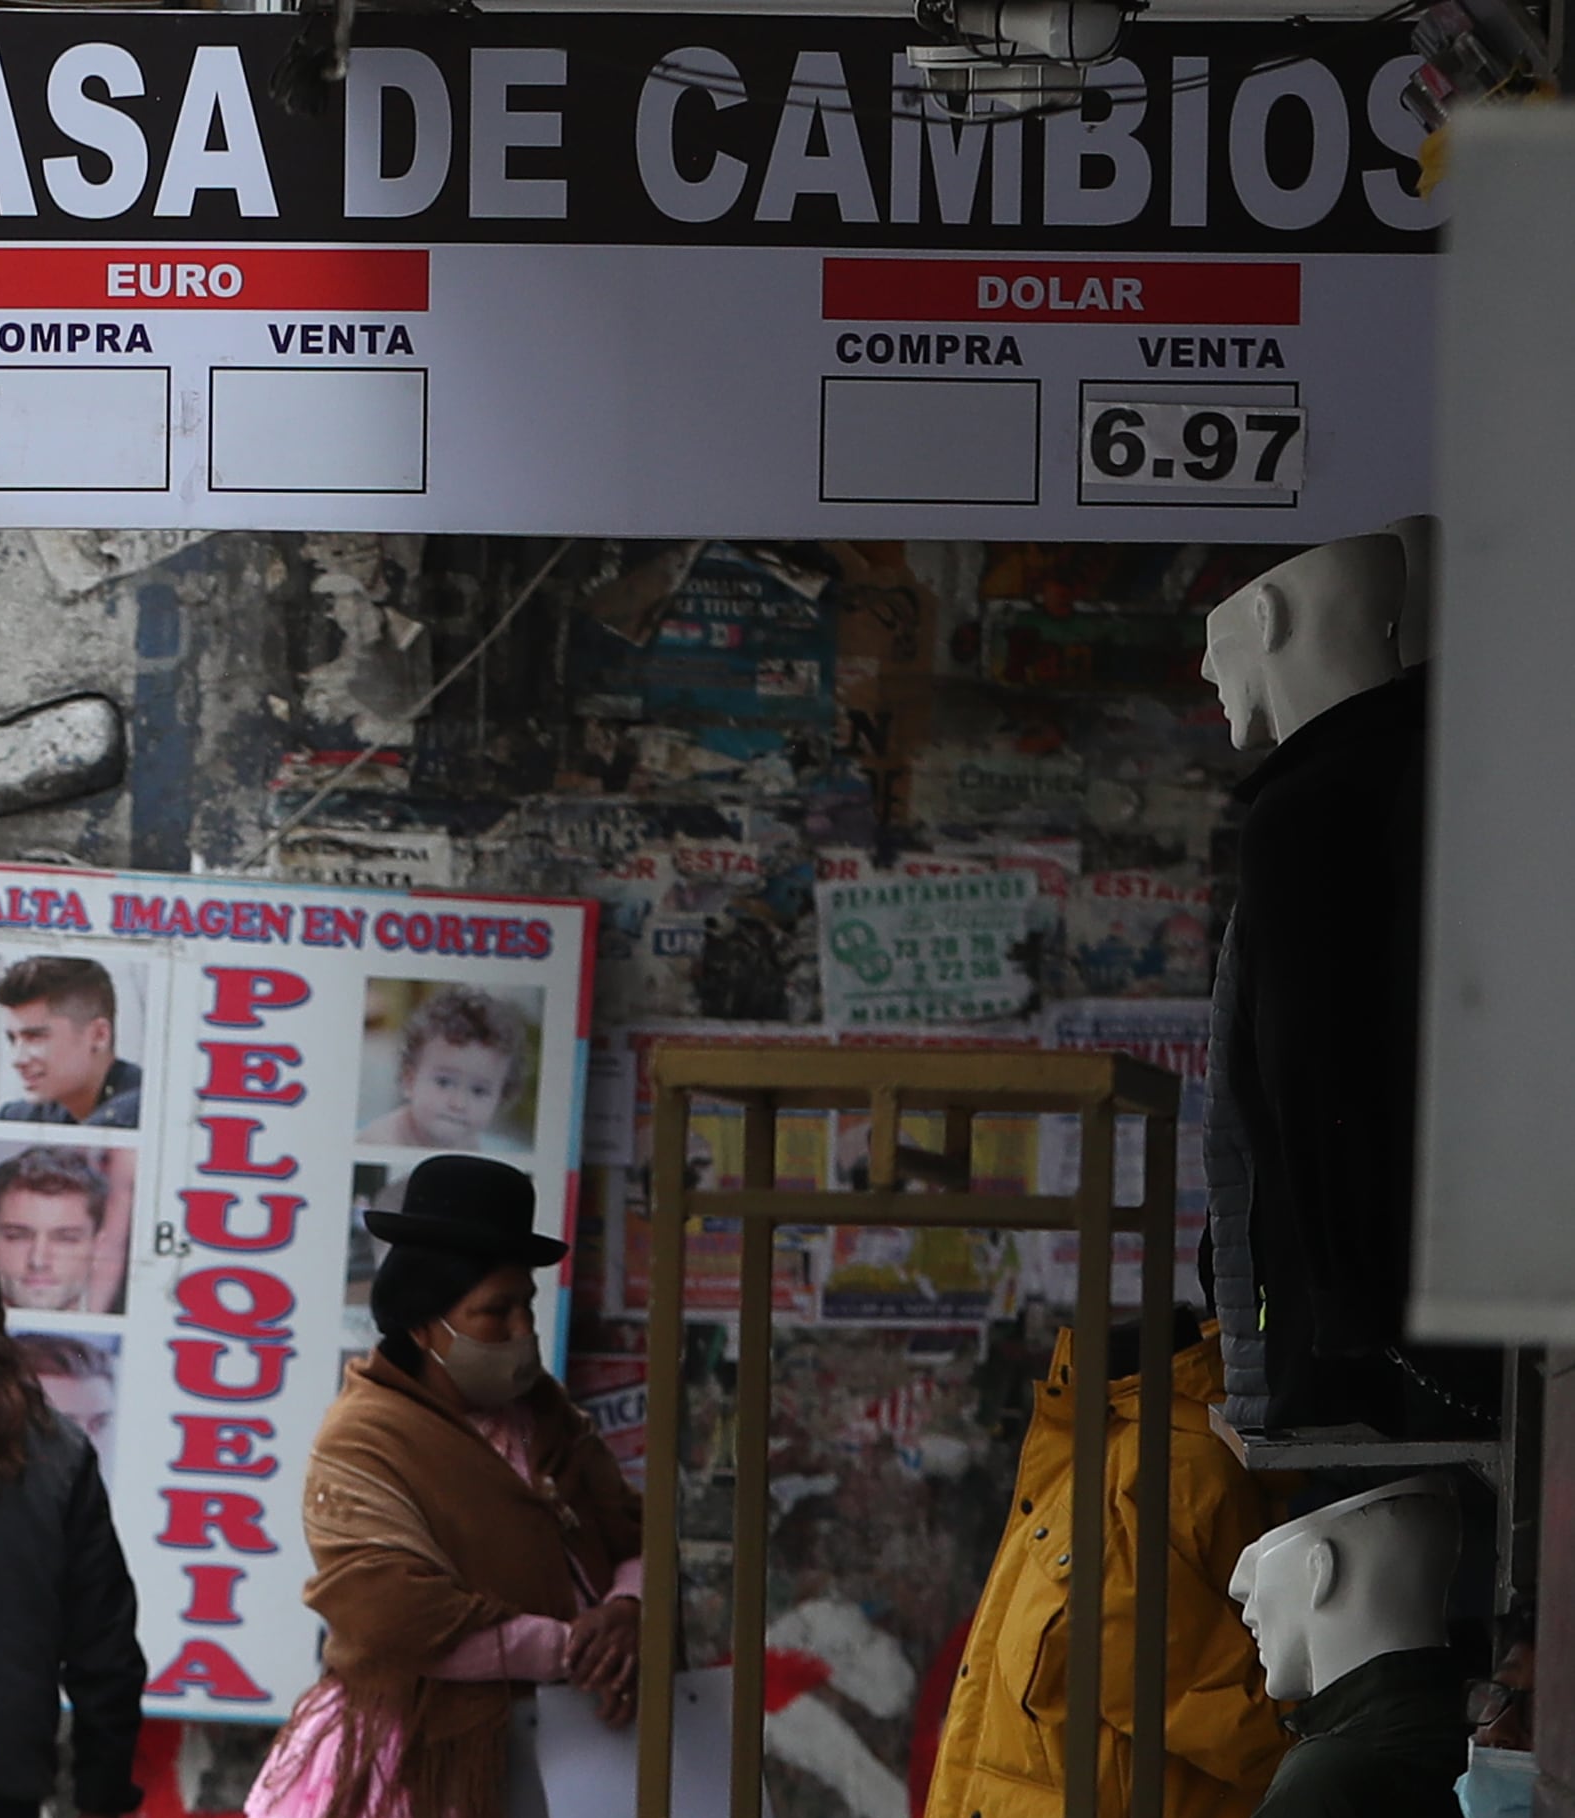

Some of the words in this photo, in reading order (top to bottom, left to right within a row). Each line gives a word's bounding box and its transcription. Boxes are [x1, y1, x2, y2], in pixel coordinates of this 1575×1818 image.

[343, 46, 568, 220] DE
[634, 44, 1451, 232] CAMBIOS
[106, 262, 244, 298] EURO
[976, 275, 1145, 312] DOLAR
[268, 323, 415, 357] VENTA
[835, 332, 1024, 367] COMPRA
[1138, 336, 1286, 371] VENTA
[1089, 408, 1302, 483] 6.97
[110, 893, 291, 945] IMAGEN
[301, 906, 366, 950] EN
[373, 910, 553, 960] CORTES
[145, 965, 311, 1703] PELUQUERIA
